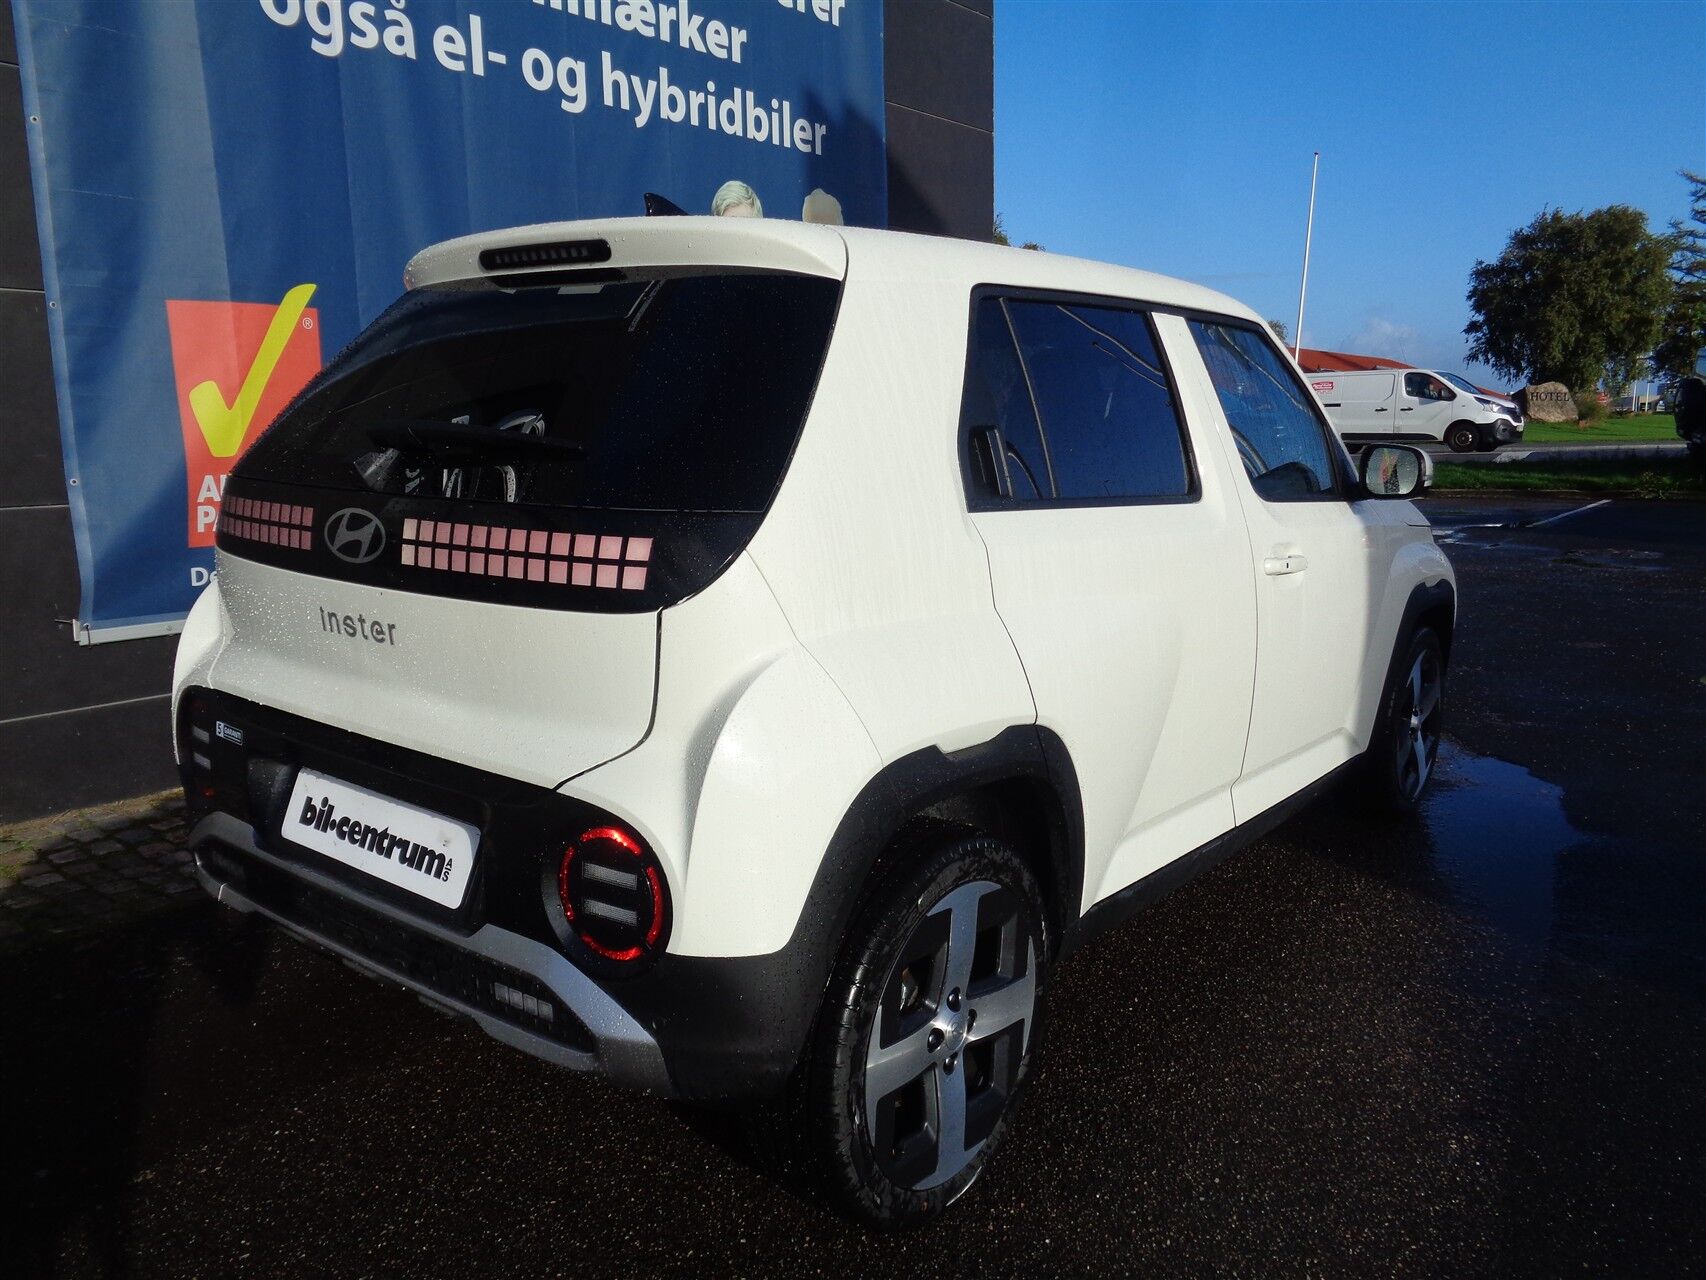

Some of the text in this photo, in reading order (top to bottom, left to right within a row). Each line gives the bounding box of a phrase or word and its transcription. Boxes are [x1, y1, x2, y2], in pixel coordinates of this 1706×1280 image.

[432, 13, 507, 77] el-
[521, 47, 587, 114] og
[601, 50, 827, 156] hybridbiler
[1530, 391, 1570, 402] HOTEL
